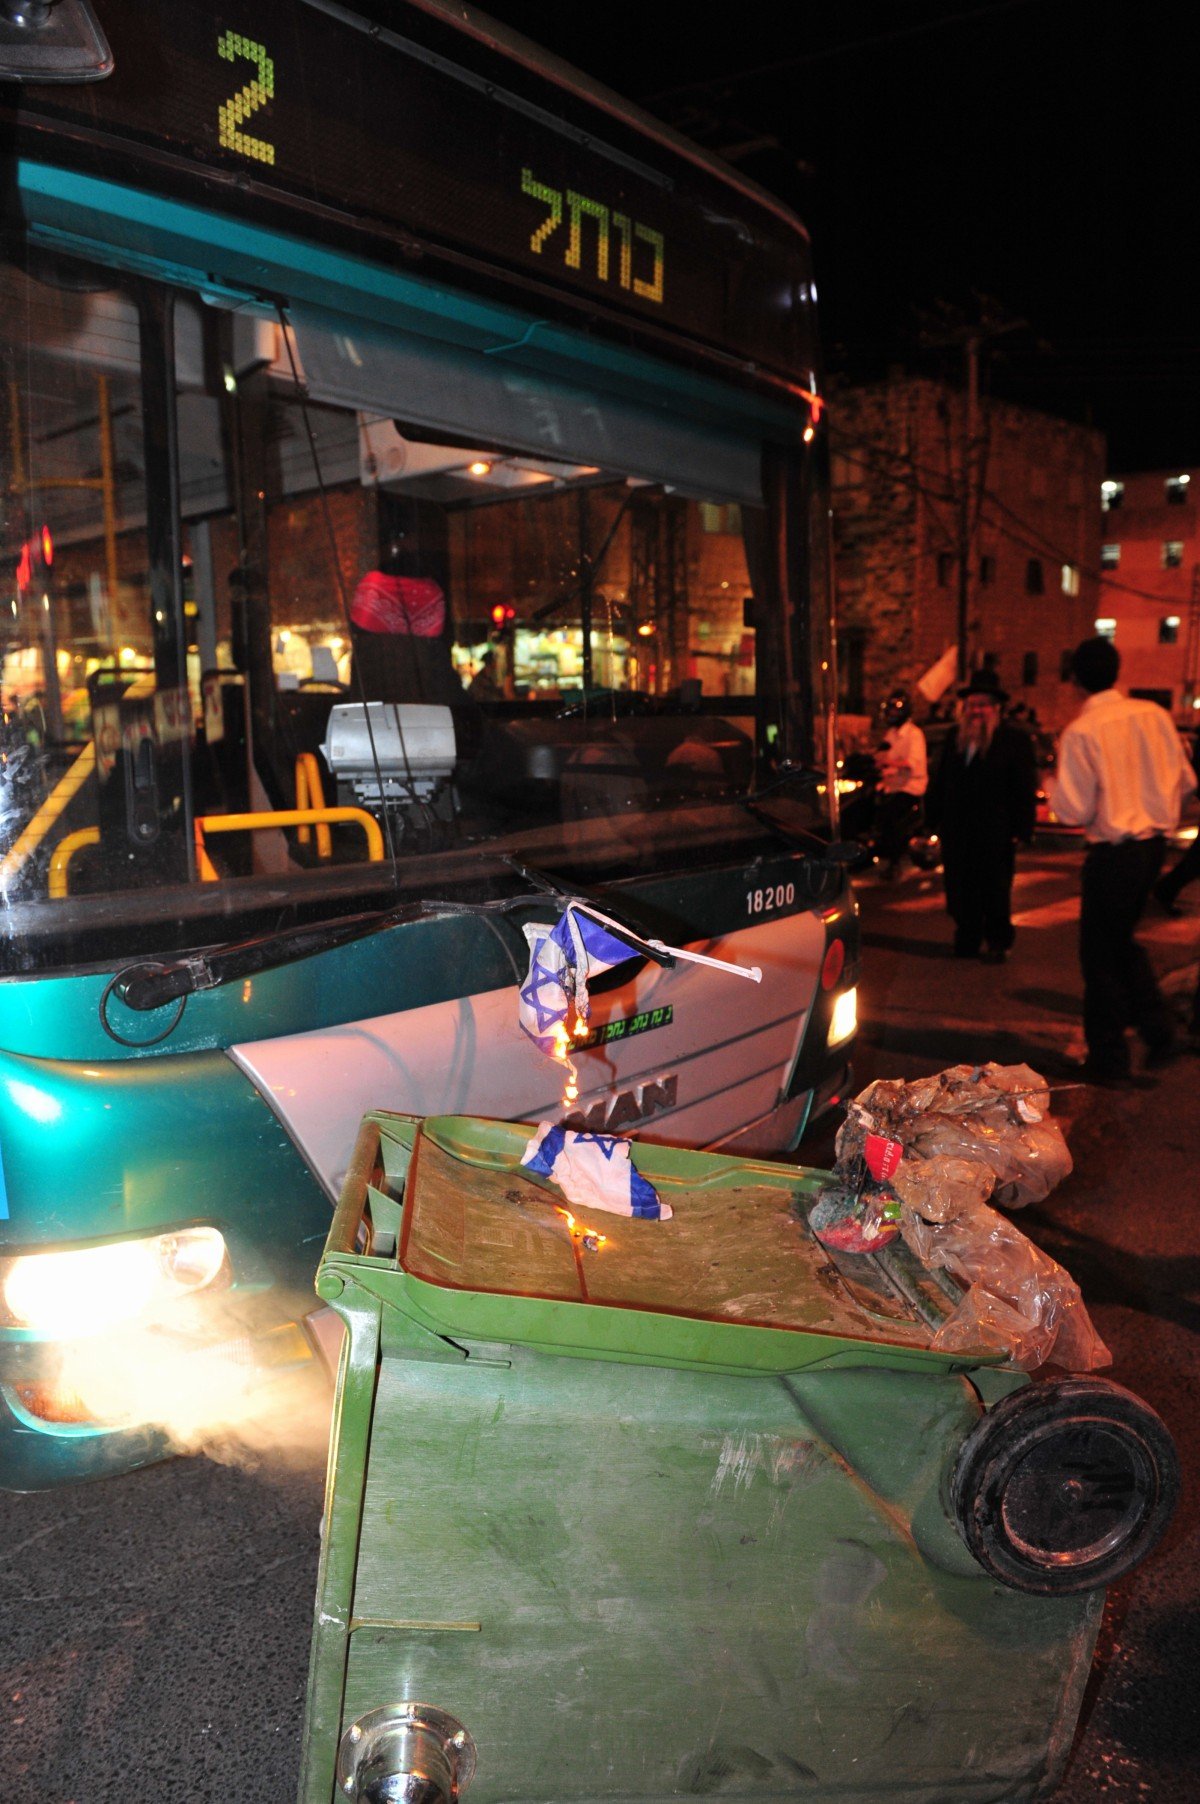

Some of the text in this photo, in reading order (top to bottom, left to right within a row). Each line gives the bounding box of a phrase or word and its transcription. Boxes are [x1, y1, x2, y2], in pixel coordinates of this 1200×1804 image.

[217, 29, 275, 166] 2
[521, 167, 664, 304] כותל
[746, 882, 795, 915] 18200
[565, 1074, 678, 1131] MAN
